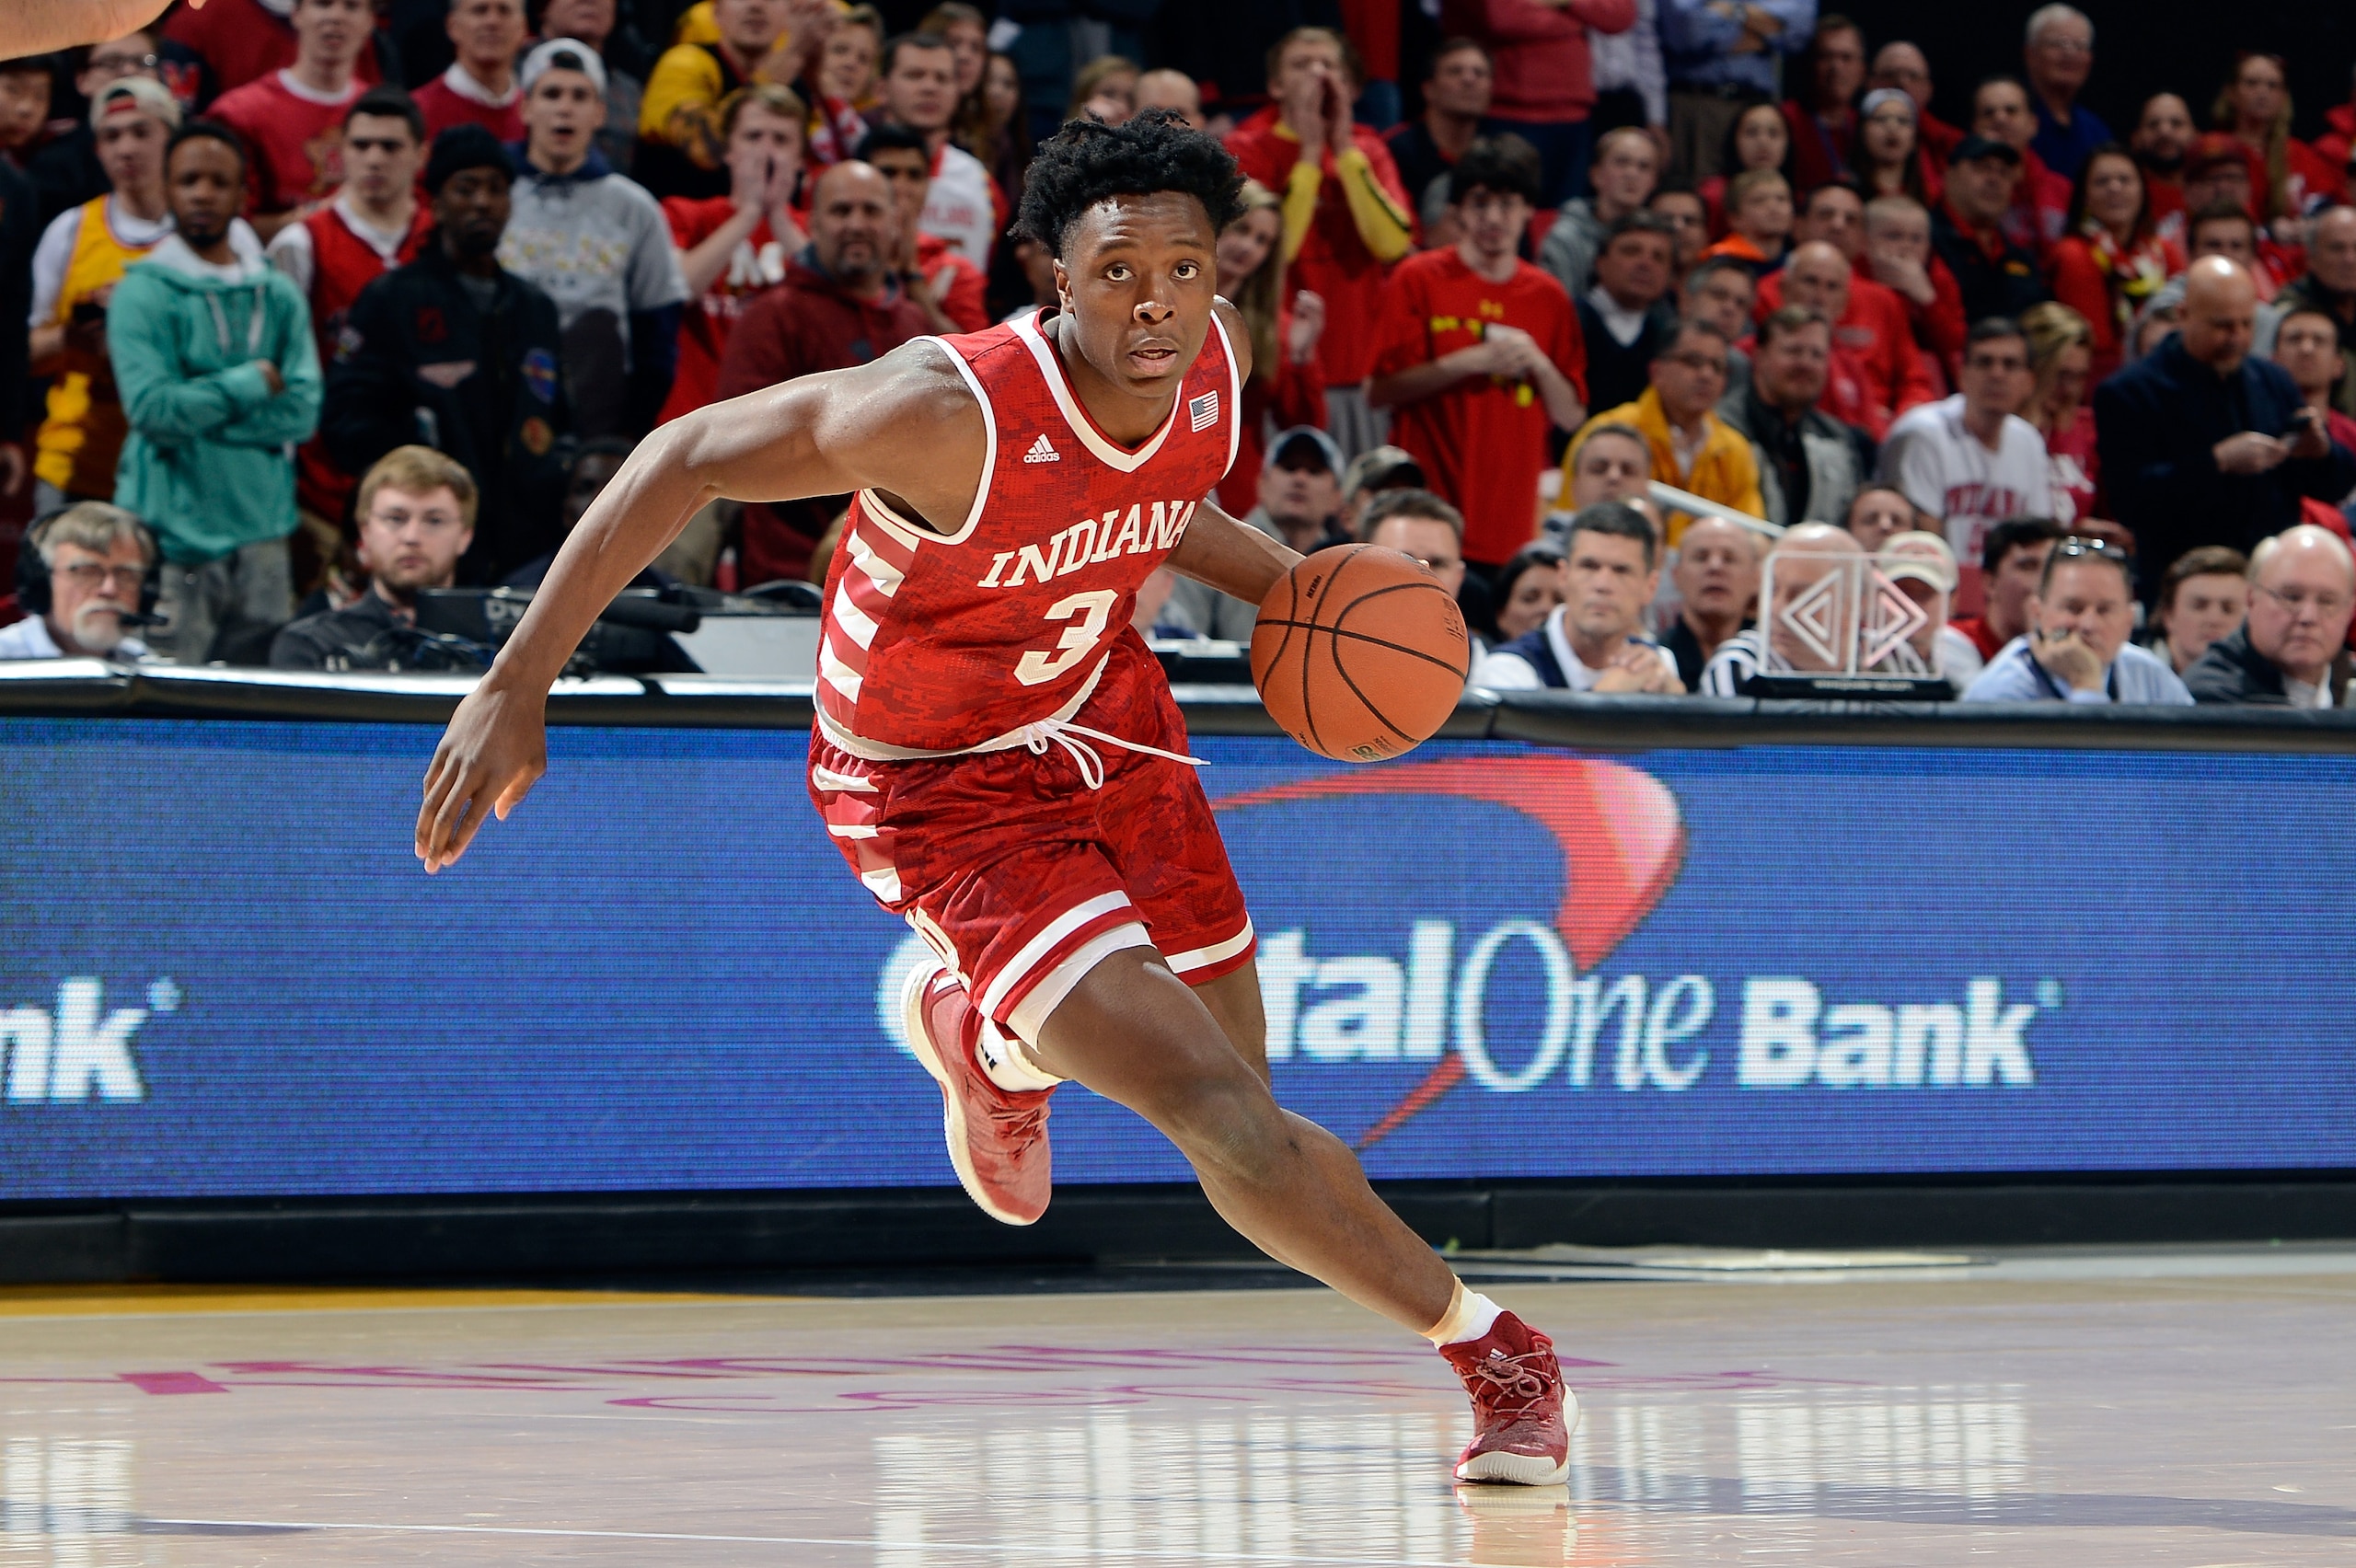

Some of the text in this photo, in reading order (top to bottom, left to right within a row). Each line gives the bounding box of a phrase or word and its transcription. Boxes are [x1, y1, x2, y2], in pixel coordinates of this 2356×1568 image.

[1022, 452, 1060, 464] adidas
[976, 500, 1196, 588] INDIANA
[1013, 588, 1119, 686] 3
[1455, 917, 1715, 1093] One
[1737, 975, 2038, 1090] Bank
